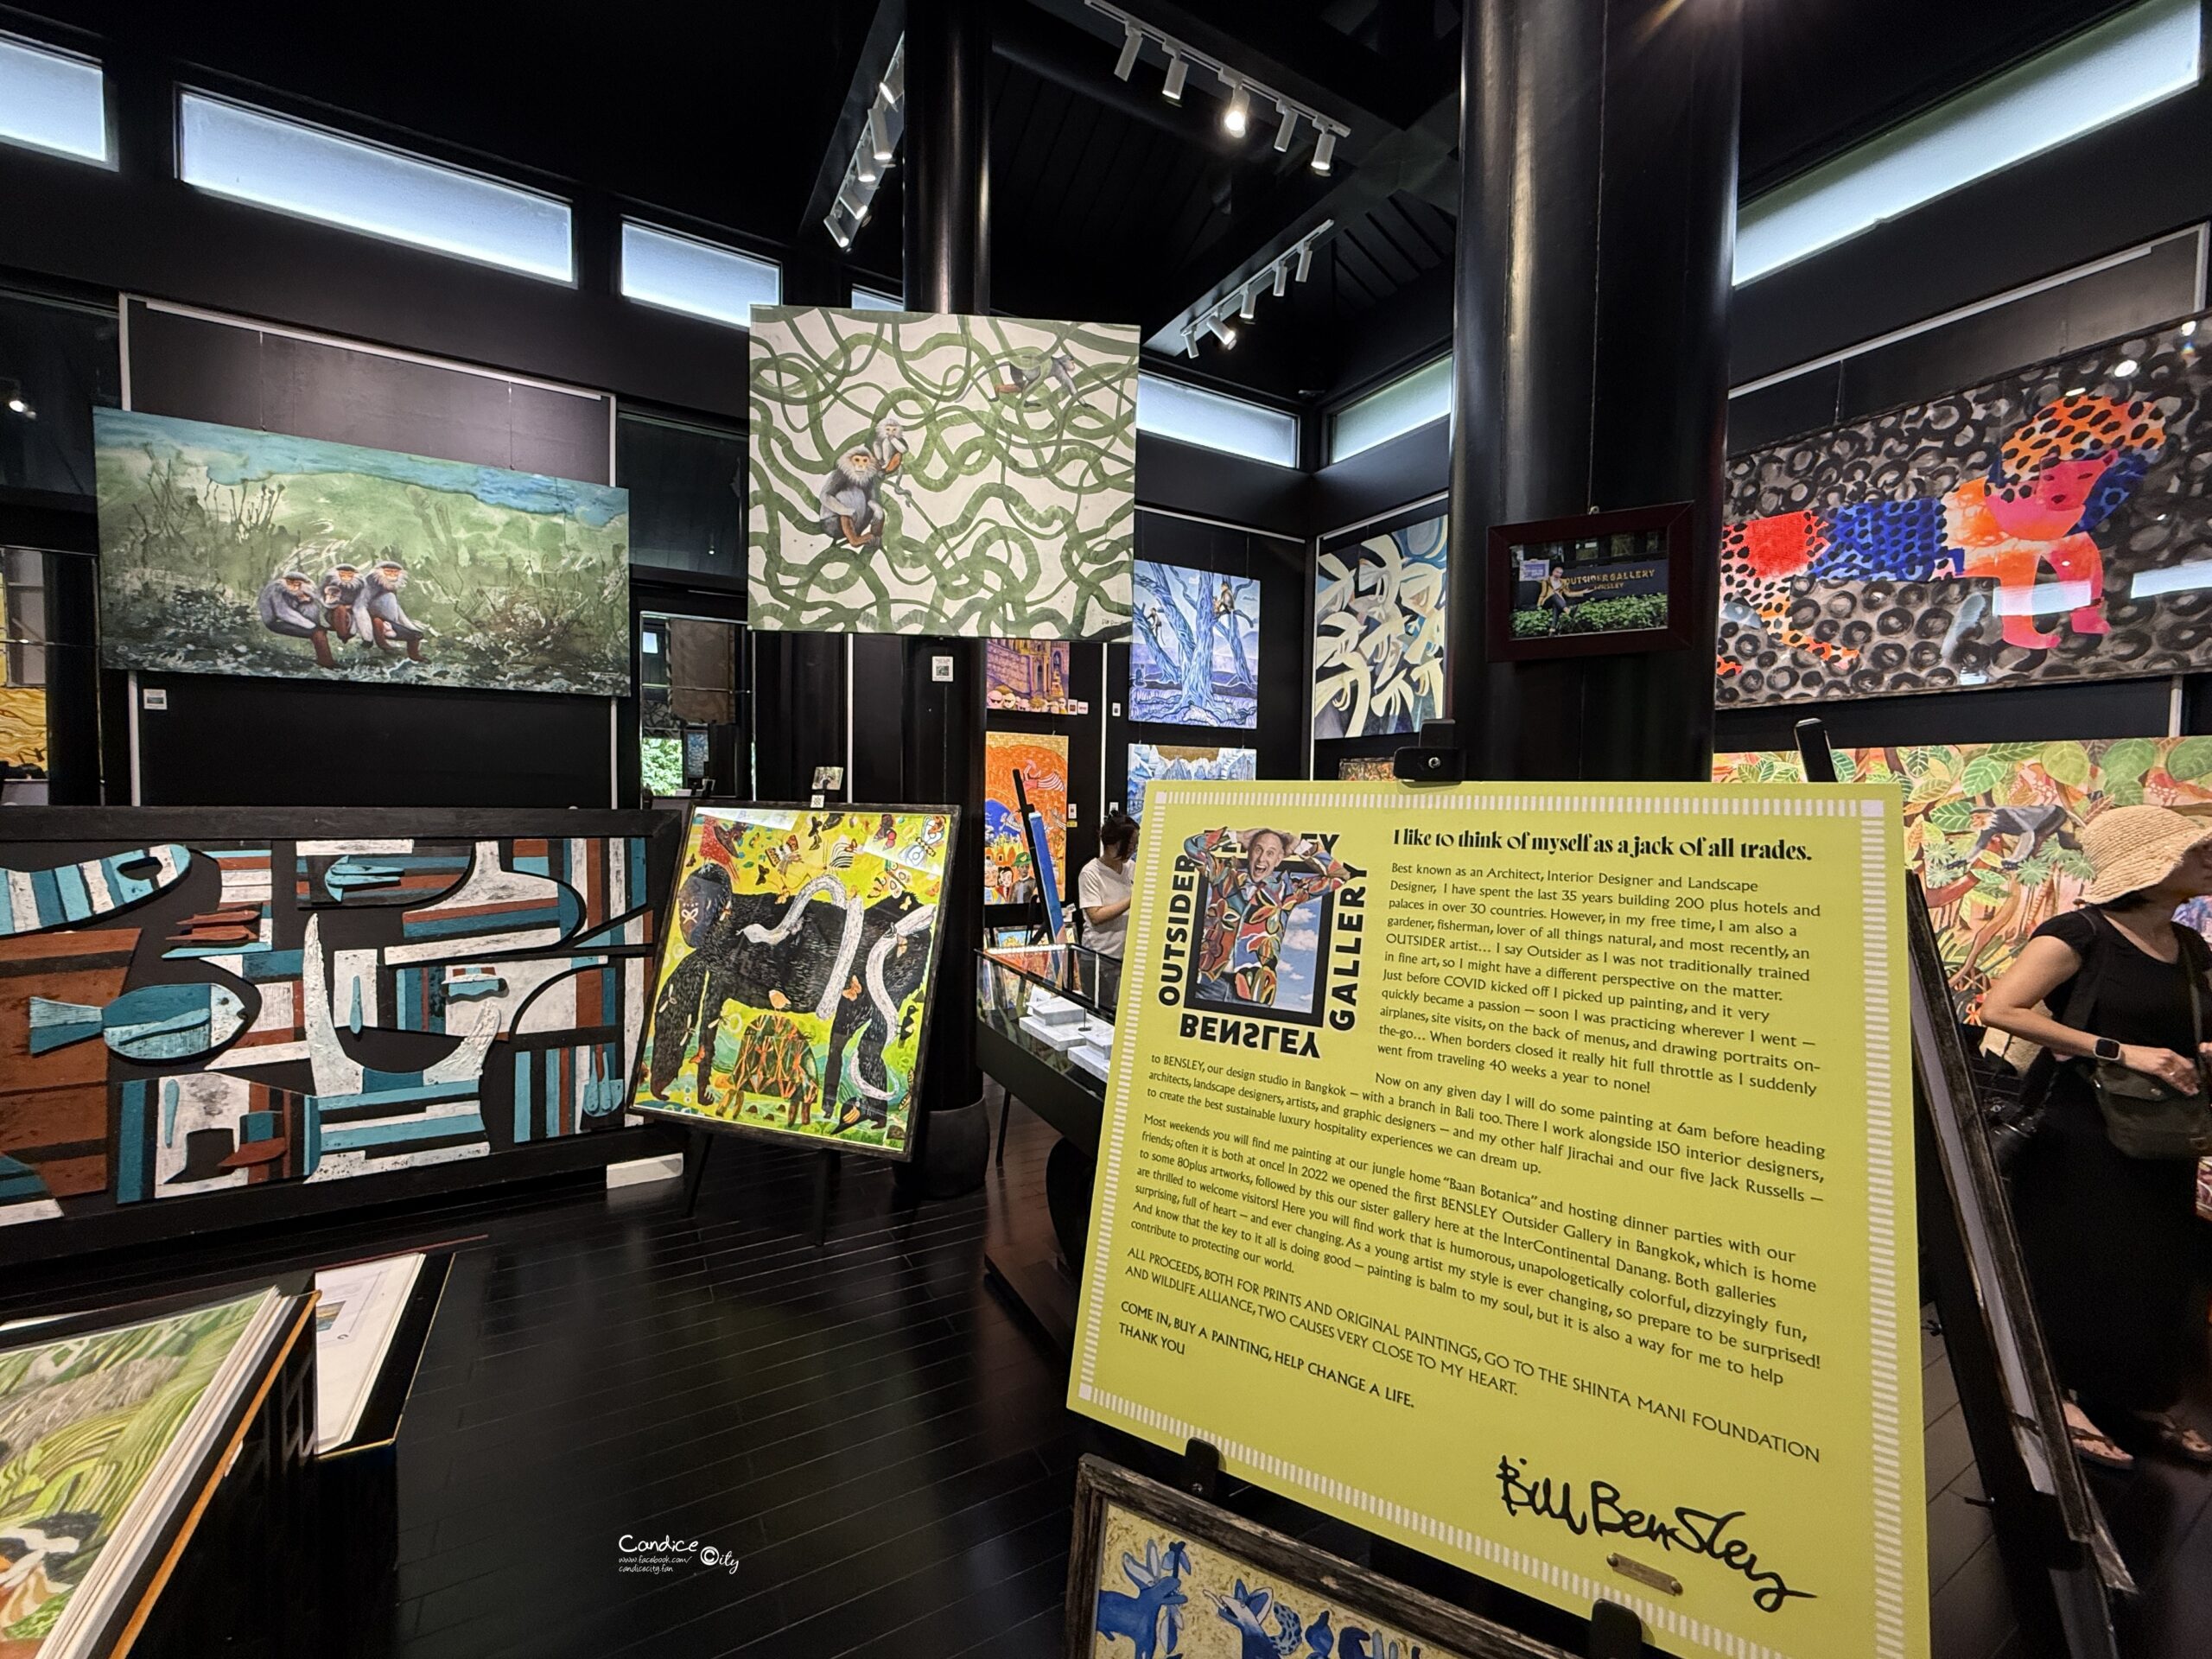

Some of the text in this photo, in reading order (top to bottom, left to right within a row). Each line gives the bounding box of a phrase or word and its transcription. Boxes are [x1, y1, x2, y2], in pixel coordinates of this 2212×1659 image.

[1610, 569, 1656, 582] GALLERY
[1393, 828, 1813, 861] I like to think of myself as a jack of all trades.
[1390, 880, 1821, 917] Designer, I have spent the last 35 years building 200 plus hotels and
[1391, 862, 1758, 893] Best known as an Architect, Interior Designer and Landscape
[1159, 855, 1196, 1006] OUTSIDER
[1329, 862, 1368, 1031] GALLERY
[1387, 916, 1809, 960] gardener, fisherman, lover of all things natural, and most recently, an
[1384, 950, 1783, 1001] in fine art, so I might have a different perspective on the matter.
[1377, 1045, 1650, 1094] went from traveling 40 weeks a year to none!
[1147, 1088, 1541, 1175] to create the best sustainable luxury hospitality experiences we can dream up.
[1375, 1071, 1826, 1160] Now on any given day I will do some painting at 6am before heading
[1141, 1130, 1816, 1293] friends; often it is both at once! In 2022 we opened the first BENSLEY Outsider Gallery in Bangkok, which is home
[1119, 1321, 1185, 1356] THANK YOU
[1121, 1300, 1414, 1408] COME IN, BUY A PAINTING, HELP CHANGE A LIFE.
[1127, 1247, 1820, 1463] ALL PROCEEDS, BOTH FOR PRINTS AND ORIGINAL PAINTINGS, GO TO THE SHINTA MANI FOUNDATION
[1496, 1455, 1587, 1535] Bill
